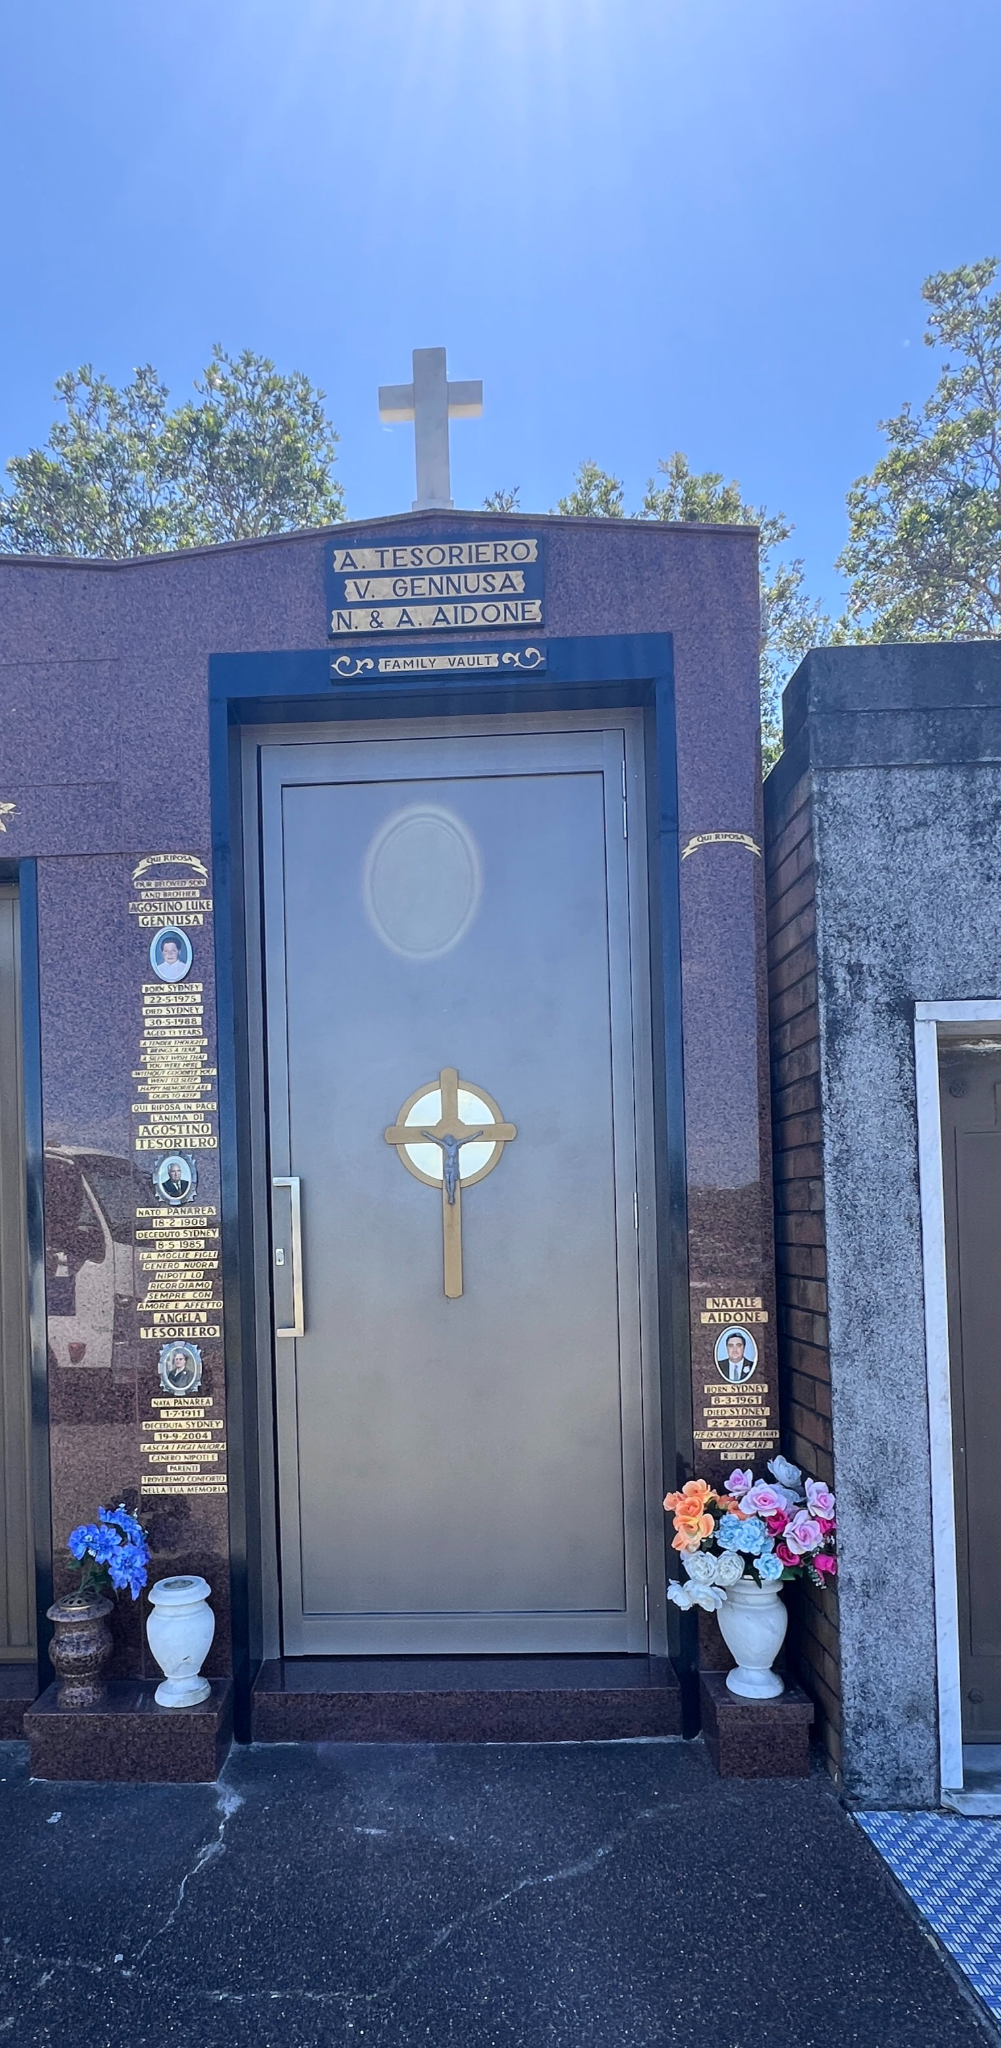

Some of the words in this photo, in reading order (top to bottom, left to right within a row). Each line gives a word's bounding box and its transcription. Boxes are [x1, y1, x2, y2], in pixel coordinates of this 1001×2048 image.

[339, 551, 366, 571] A.
[375, 542, 531, 568] TESORIERO
[353, 580, 375, 599] V.
[392, 572, 518, 597] GENNUSA
[336, 611, 359, 630] N.
[369, 610, 384, 629] &
[396, 608, 422, 627] A.
[432, 601, 537, 626] AIDONE
[384, 657, 437, 670] FAMILY
[448, 655, 492, 667] VAULT
[130, 901, 183, 912] AGOSTINO
[186, 900, 212, 911] LUKE
[141, 915, 200, 926] GENNUSA
[167, 984, 200, 992] SYDNEY
[149, 995, 197, 1003] 22-5-1975
[196, 1102, 216, 1110] PACE
[141, 1124, 210, 1136] AGOSTINO
[137, 1137, 216, 1149] TESORIERO
[167, 1207, 215, 1215] PANAREA
[137, 1230, 180, 1239] DECEDUTO
[183, 1229, 217, 1237] SYDNEY
[150, 1281, 210, 1289] RICORDIAMO
[148, 1292, 186, 1300] SEMPRE
[138, 1302, 170, 1310] AMORE
[184, 1301, 222, 1309] AFFETTO
[711, 1298, 756, 1308] NATALE
[158, 1313, 202, 1323] ANGELA
[708, 1312, 761, 1323] AIDONE
[144, 1327, 217, 1338] TESORIERO
[731, 1384, 765, 1392] SYDNEY
[173, 1398, 211, 1406] PANAREA
[187, 1485, 227, 1493] MEMORIA
